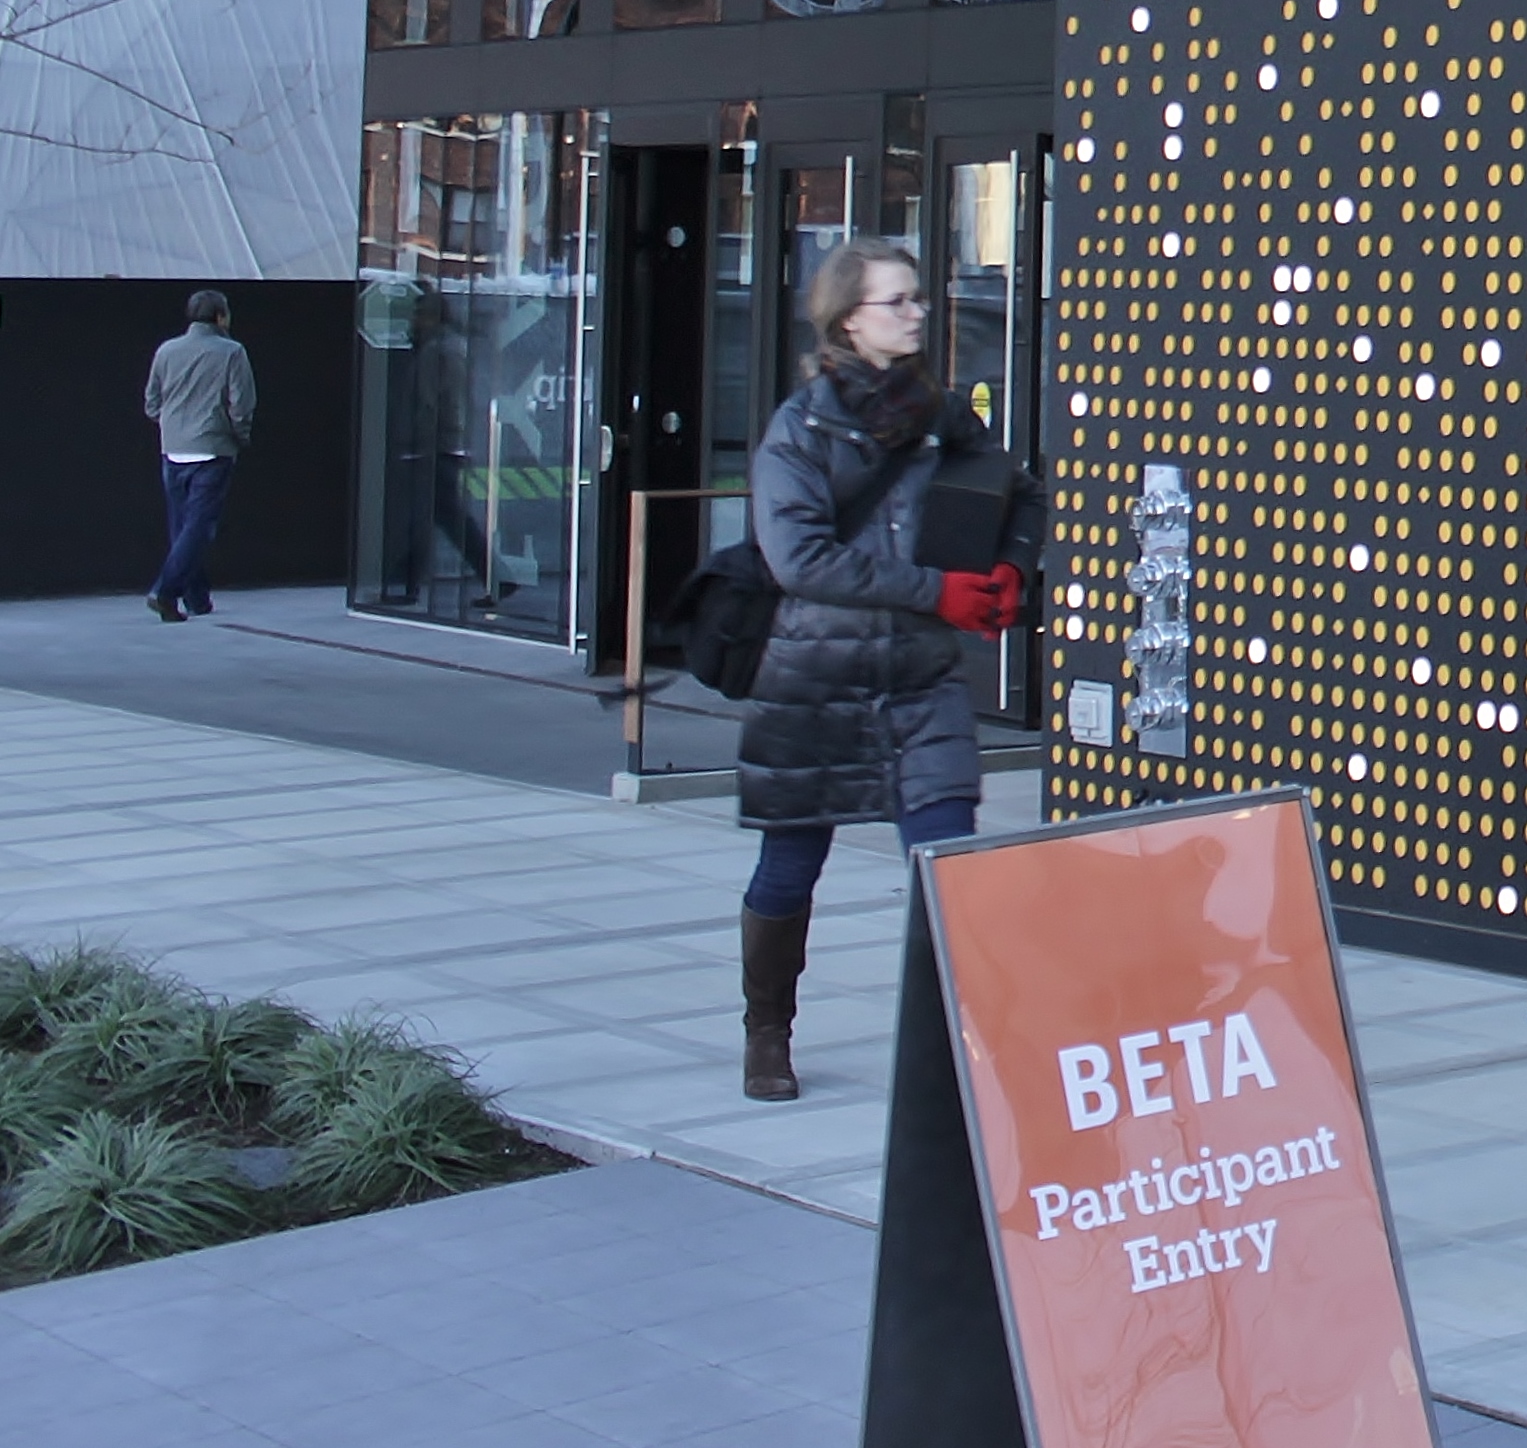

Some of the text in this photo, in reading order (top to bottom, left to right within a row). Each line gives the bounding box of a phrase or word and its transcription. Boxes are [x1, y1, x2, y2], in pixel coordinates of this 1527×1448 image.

[1056, 1012, 1278, 1133] BETA
[1029, 1125, 1341, 1241] Participant
[1122, 1217, 1278, 1294] Entry
